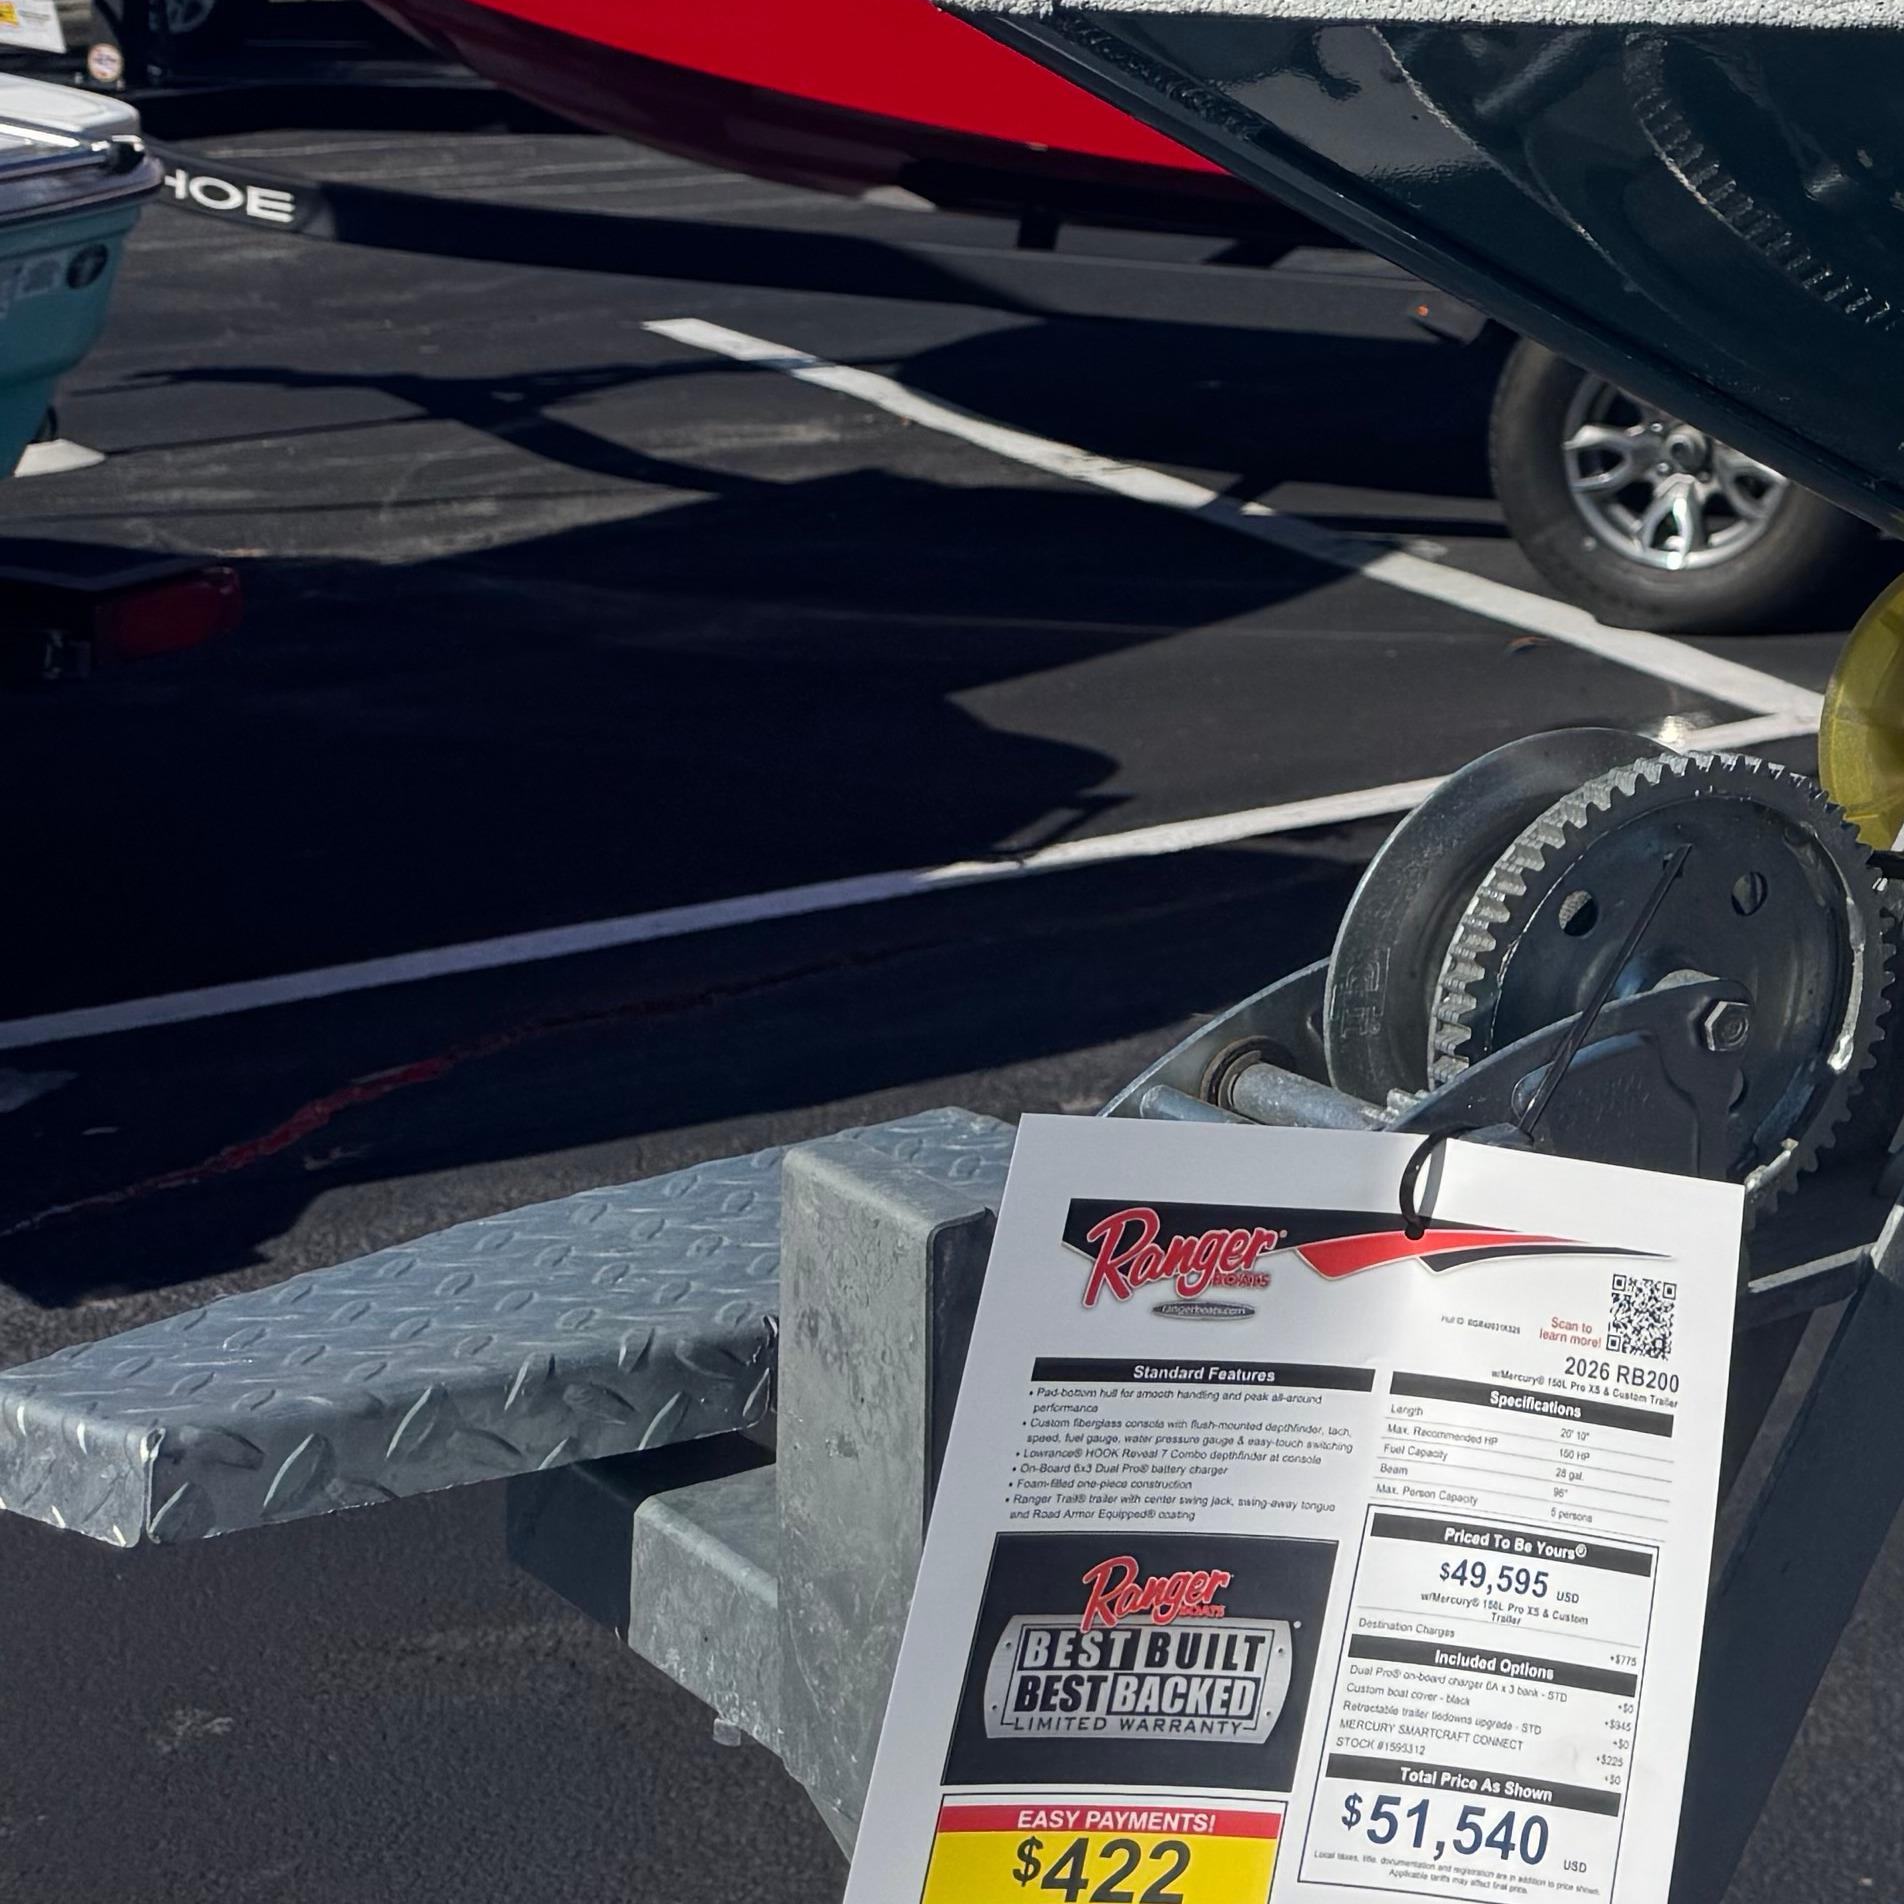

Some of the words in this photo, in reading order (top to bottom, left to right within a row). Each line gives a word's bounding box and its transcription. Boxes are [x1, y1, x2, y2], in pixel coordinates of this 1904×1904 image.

[1082, 1206, 1278, 1309] Ranger
[1161, 1302, 1247, 1316] rangerboats.com
[1551, 1316, 1579, 1332] Scan
[1539, 1327, 1568, 1343] learn
[1569, 1335, 1602, 1349] more!
[1133, 1364, 1203, 1382] Standard
[1208, 1367, 1276, 1383] Features
[1564, 1356, 1610, 1381] 2026
[1616, 1364, 1680, 1394] RB200
[1099, 1388, 1119, 1399] hull
[1120, 1388, 1135, 1399] for
[1136, 1389, 1174, 1399] smooth
[1176, 1389, 1220, 1402] handling
[1222, 1391, 1242, 1401] and
[1243, 1392, 1269, 1403] peak
[1488, 1390, 1582, 1419] Specifications
[1570, 1380, 1586, 1393] Pro
[1612, 1387, 1647, 1403] Custom
[1650, 1394, 1678, 1408] Trailer
[1032, 1402, 1099, 1415] performance
[1390, 1403, 1424, 1418] Length
[1030, 1417, 1070, 1428] Custom
[1073, 1417, 1123, 1430] fiberglass
[1124, 1419, 1165, 1429] console
[1167, 1420, 1188, 1429] with
[1190, 1418, 1264, 1432] flush-mounted
[1413, 1426, 1483, 1445] Recommended
[1064, 1432, 1084, 1443] fuel
[1124, 1434, 1153, 1444] water
[1154, 1435, 1200, 1446] pressure
[1202, 1436, 1235, 1448] gauge
[1247, 1438, 1304, 1449] easy-touch
[1306, 1441, 1354, 1454] switching
[1383, 1443, 1406, 1455] Fuel
[1407, 1445, 1448, 1462] Capacity
[1084, 1447, 1119, 1459] HOOK
[1121, 1448, 1159, 1459] Reveal
[1170, 1448, 1208, 1460] Combo
[1209, 1450, 1268, 1462] depthfinder
[1281, 1454, 1322, 1465] console
[1019, 1462, 1072, 1474] On-Board
[1094, 1463, 1120, 1474] Dual
[1121, 1463, 1150, 1474] Pro®
[1151, 1464, 1187, 1476] battery
[1189, 1465, 1228, 1477] charger
[1379, 1462, 1409, 1476] Beam
[1016, 1478, 1076, 1489] Foam-filled
[1076, 1479, 1128, 1491] one-piece
[1130, 1479, 1193, 1489] construction
[1013, 1493, 1052, 1507] Ranger
[1088, 1494, 1118, 1504] trailer
[1120, 1494, 1141, 1504] with
[1144, 1495, 1177, 1505] center
[1178, 1495, 1209, 1508] swing
[1209, 1495, 1234, 1508] jack,
[1301, 1501, 1336, 1513] tongue
[1402, 1485, 1436, 1499] Person
[1438, 1489, 1479, 1507] Capacity
[1558, 1510, 1593, 1524] persons
[1009, 1510, 1031, 1520] and
[1032, 1508, 1062, 1519] Road
[1062, 1509, 1095, 1519] Armor
[1097, 1508, 1157, 1521] Equipped®
[1158, 1510, 1196, 1522] coating
[1443, 1527, 1490, 1546] Priced
[1536, 1543, 1588, 1561] Yours®
[1439, 1559, 1549, 1598] $49,595
[1556, 1591, 1580, 1604] USD
[1081, 1555, 1231, 1633] Ranger
[1490, 1611, 1523, 1625] Trailer
[1507, 1602, 1525, 1617] Pro
[1552, 1609, 1589, 1625] Custom
[1358, 1617, 1413, 1632] Destination
[1415, 1623, 1455, 1639] Charges
[1023, 1630, 1131, 1668] BEST
[1145, 1631, 1266, 1672] BUILT
[1434, 1649, 1496, 1671] Included
[1499, 1658, 1555, 1681] Options
[1346, 1682, 1385, 1696] Custom
[1386, 1687, 1409, 1699] boat
[1410, 1691, 1438, 1702] cover
[1445, 1693, 1470, 1706] black
[1349, 1664, 1374, 1676] Dual
[1402, 1671, 1447, 1685] on-board
[1447, 1677, 1484, 1691] charger
[1516, 1686, 1539, 1698] bank
[1547, 1690, 1568, 1703] STD
[1014, 1675, 1108, 1713] BEST
[1111, 1676, 1256, 1717] BACKED
[1013, 1716, 1107, 1731] LIMITED
[1119, 1718, 1242, 1735] WARRANTY
[1342, 1699, 1399, 1716] Retractable
[1401, 1707, 1429, 1719] trailer
[1431, 1711, 1473, 1725] tiedowns
[1474, 1718, 1513, 1731] upgrade
[1521, 1722, 1542, 1736] STD
[1336, 1736, 1374, 1750] STOCK
[1339, 1717, 1396, 1733] MERCURY
[1397, 1724, 1471, 1743] SMARTCRAFT
[1472, 1733, 1524, 1751] CONNECT
[1399, 1766, 1437, 1785] Total
[1440, 1771, 1478, 1790] Price
[1504, 1780, 1553, 1803] Shown
[1018, 1809, 1083, 1828] EASY
[1084, 1812, 1216, 1832] PAYMENTS!
[1341, 1793, 1550, 1866] $51,540
[1563, 1859, 1587, 1874] USD
[1012, 1835, 1191, 1904] $422
